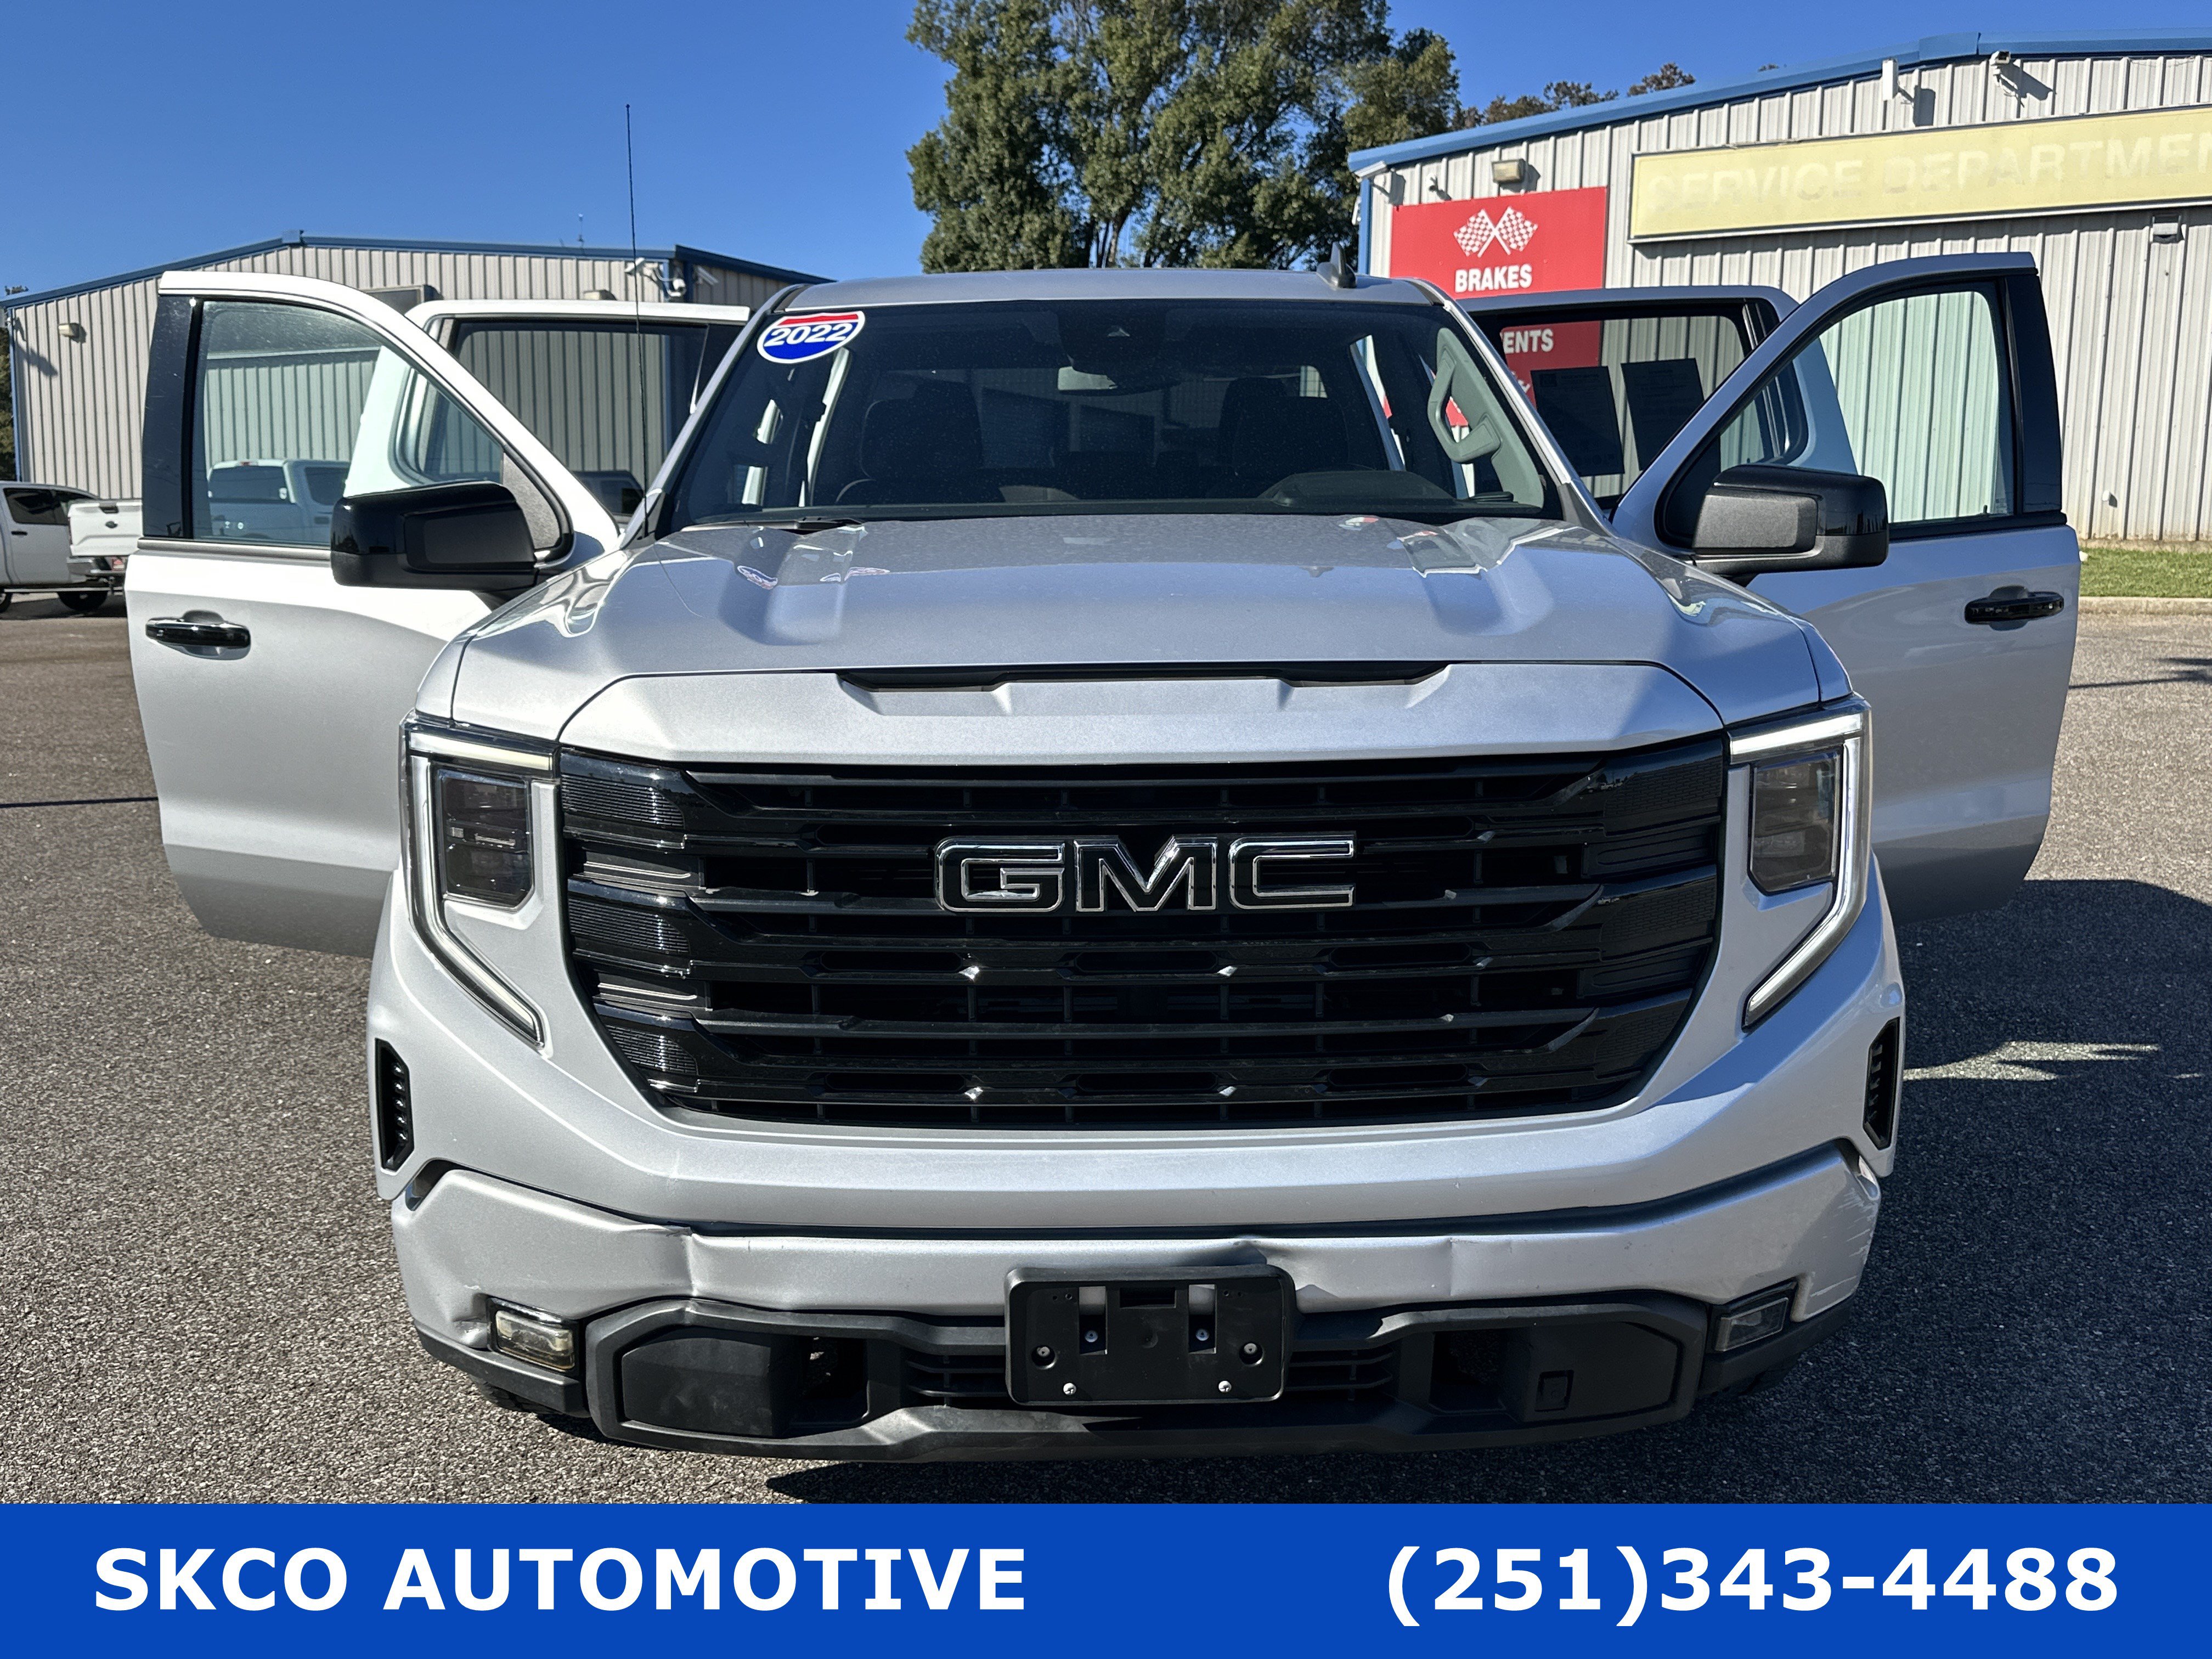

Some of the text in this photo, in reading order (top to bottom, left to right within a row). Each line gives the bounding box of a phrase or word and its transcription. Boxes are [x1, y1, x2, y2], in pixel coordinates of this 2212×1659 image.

[1647, 159, 1865, 213] SERVICE
[1454, 263, 1533, 293] BRAKES
[763, 322, 853, 347] 2022
[1500, 329, 1554, 354] ENTS
[934, 831, 1356, 912] GMC
